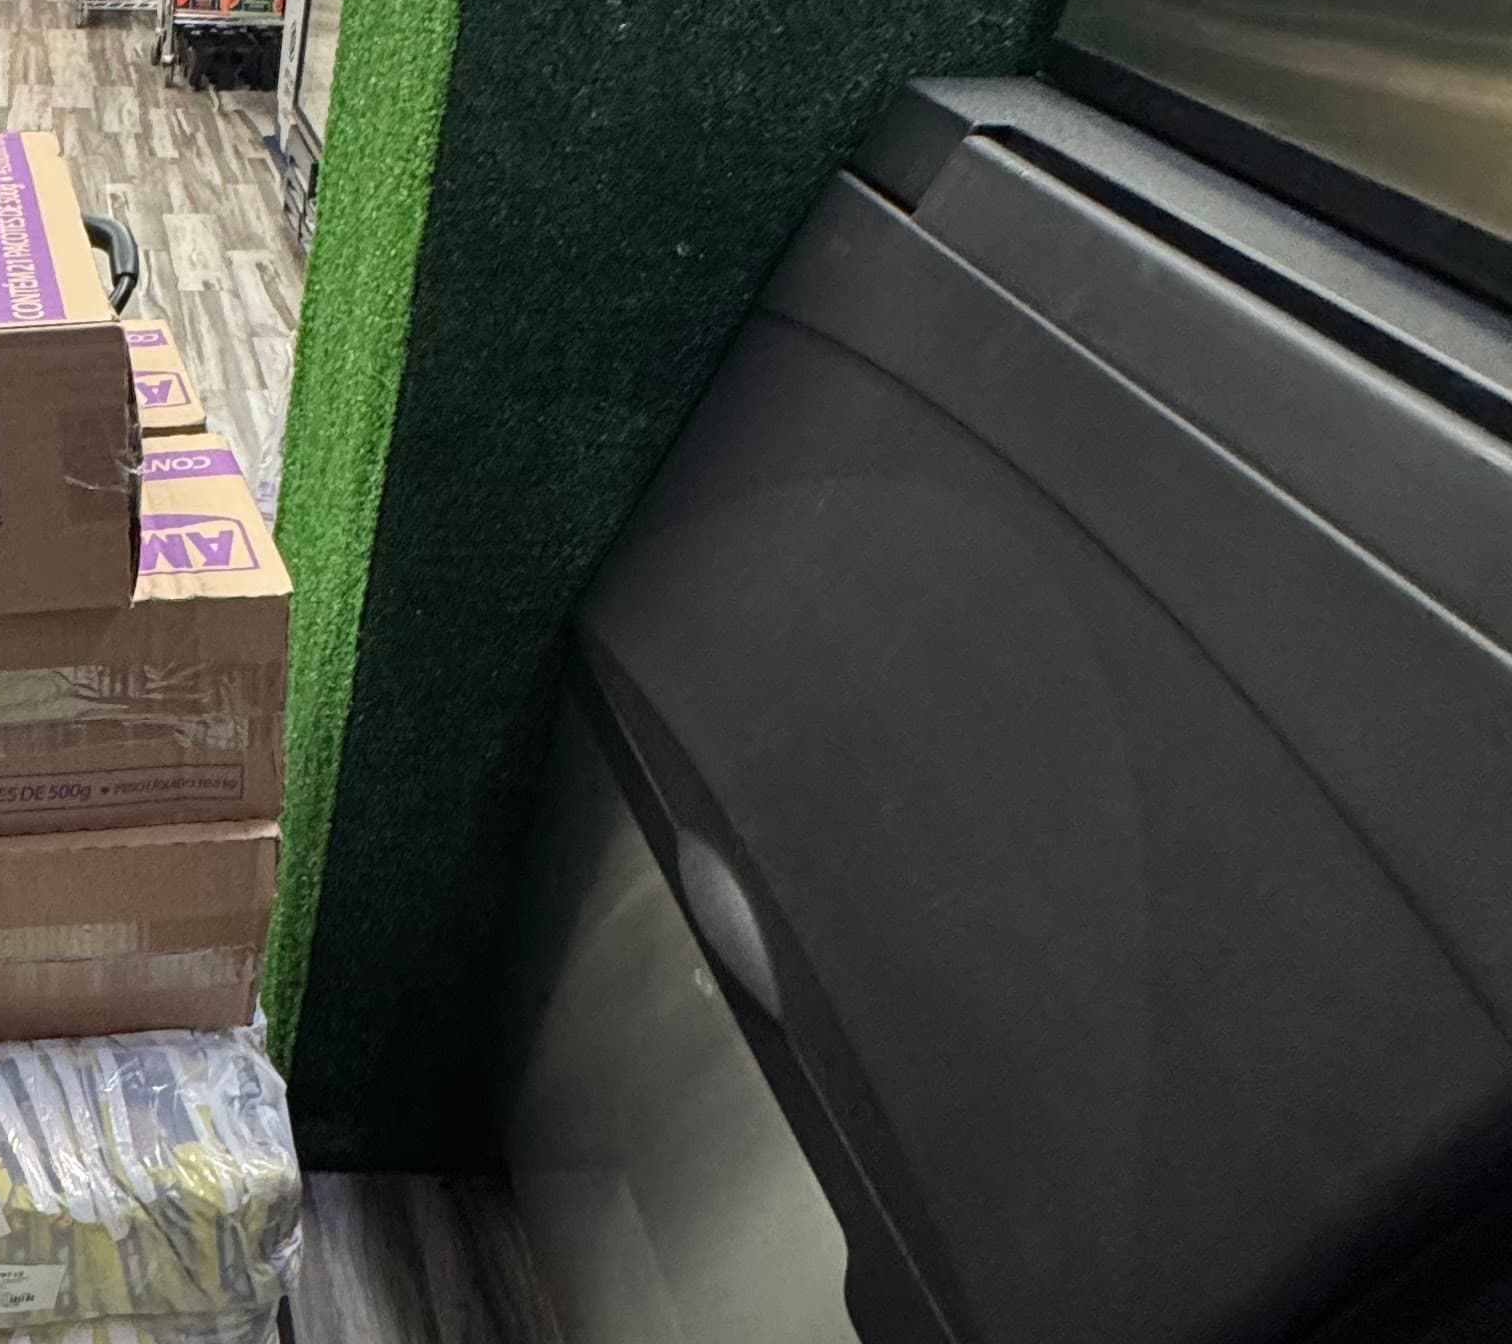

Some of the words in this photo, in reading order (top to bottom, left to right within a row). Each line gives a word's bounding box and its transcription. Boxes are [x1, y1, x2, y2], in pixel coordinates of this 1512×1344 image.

[6, 257, 35, 272] 21
[3, 272, 45, 319] CONTÉM
[144, 456, 211, 471] CON
[19, 785, 47, 802] DE
[48, 782, 92, 804] 500g
